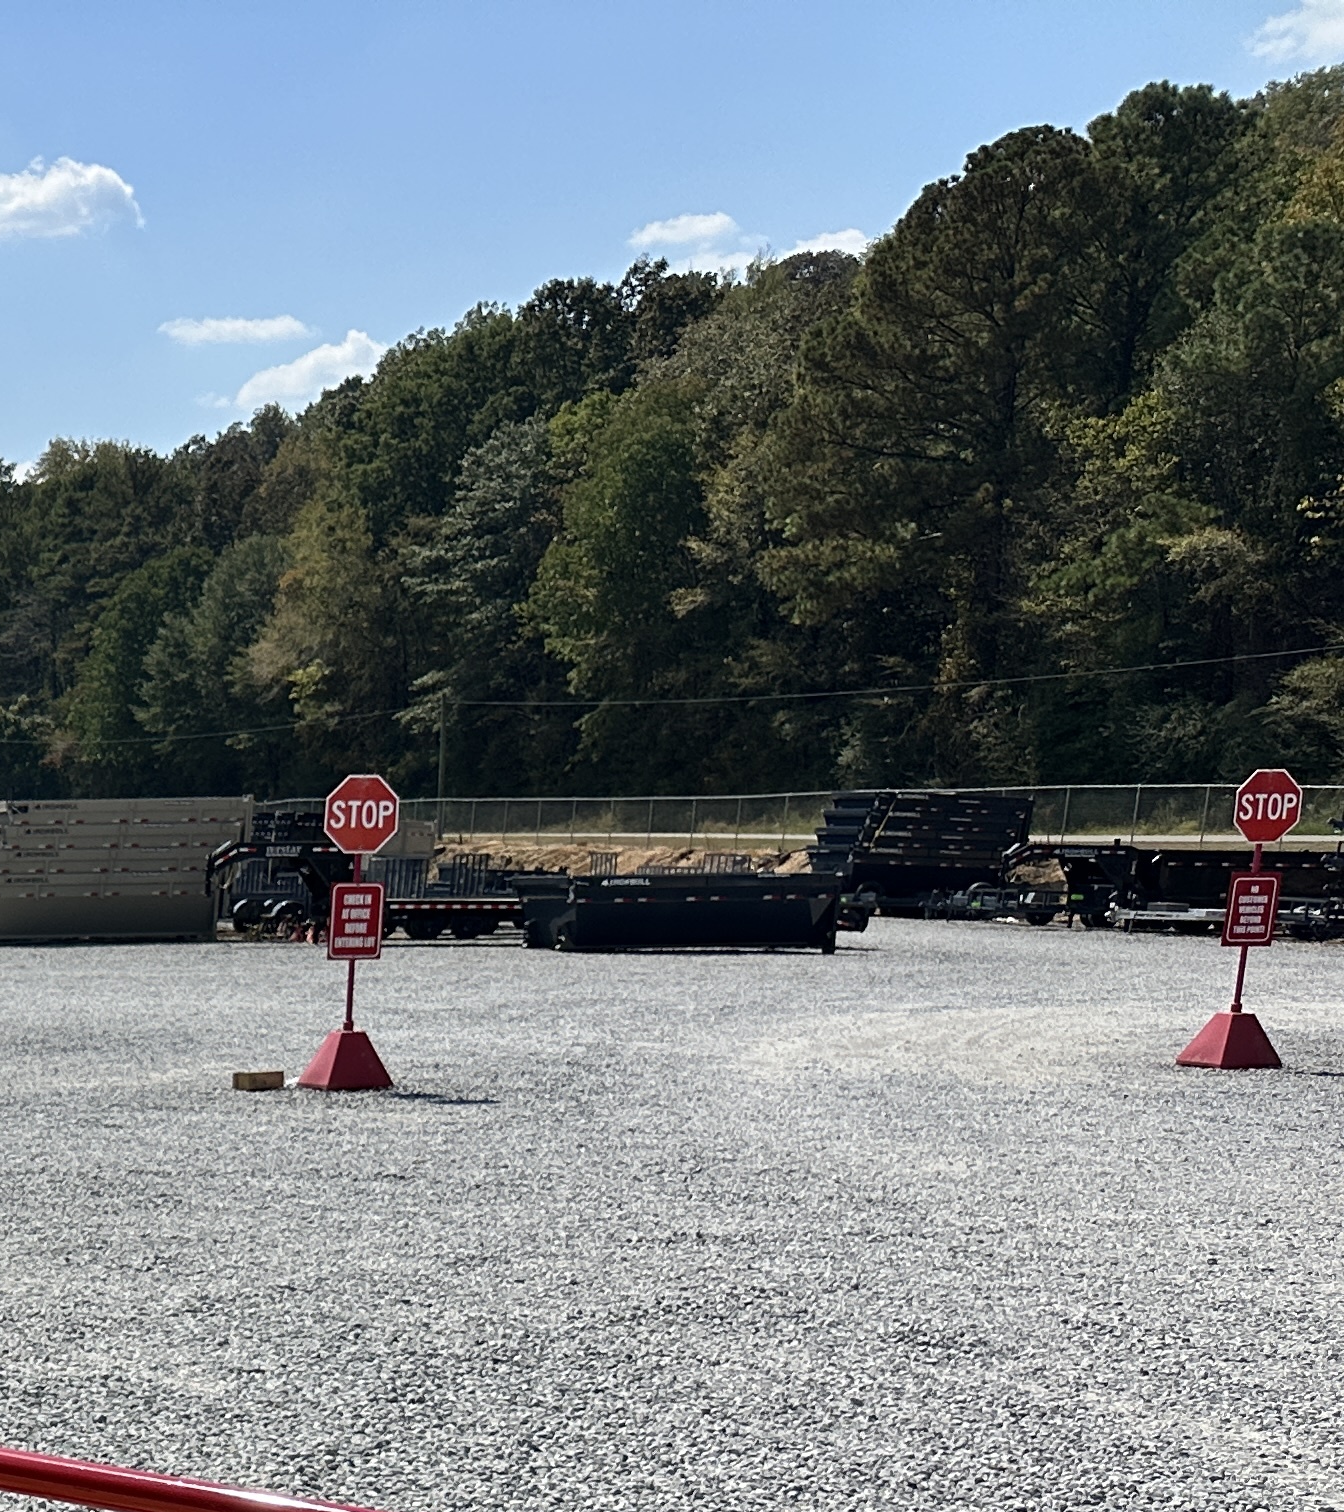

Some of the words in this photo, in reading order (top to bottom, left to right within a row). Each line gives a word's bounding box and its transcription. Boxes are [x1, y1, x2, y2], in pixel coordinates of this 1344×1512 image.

[1238, 793, 1298, 821] STOP
[329, 800, 394, 829] STOP
[343, 894, 364, 905] CHECK
[364, 894, 372, 905] IN
[341, 908, 350, 919] AT
[350, 908, 370, 919] OFFICE
[344, 922, 368, 934] BEFORE
[334, 936, 363, 948] ENTERING
[363, 936, 376, 948] LOT
